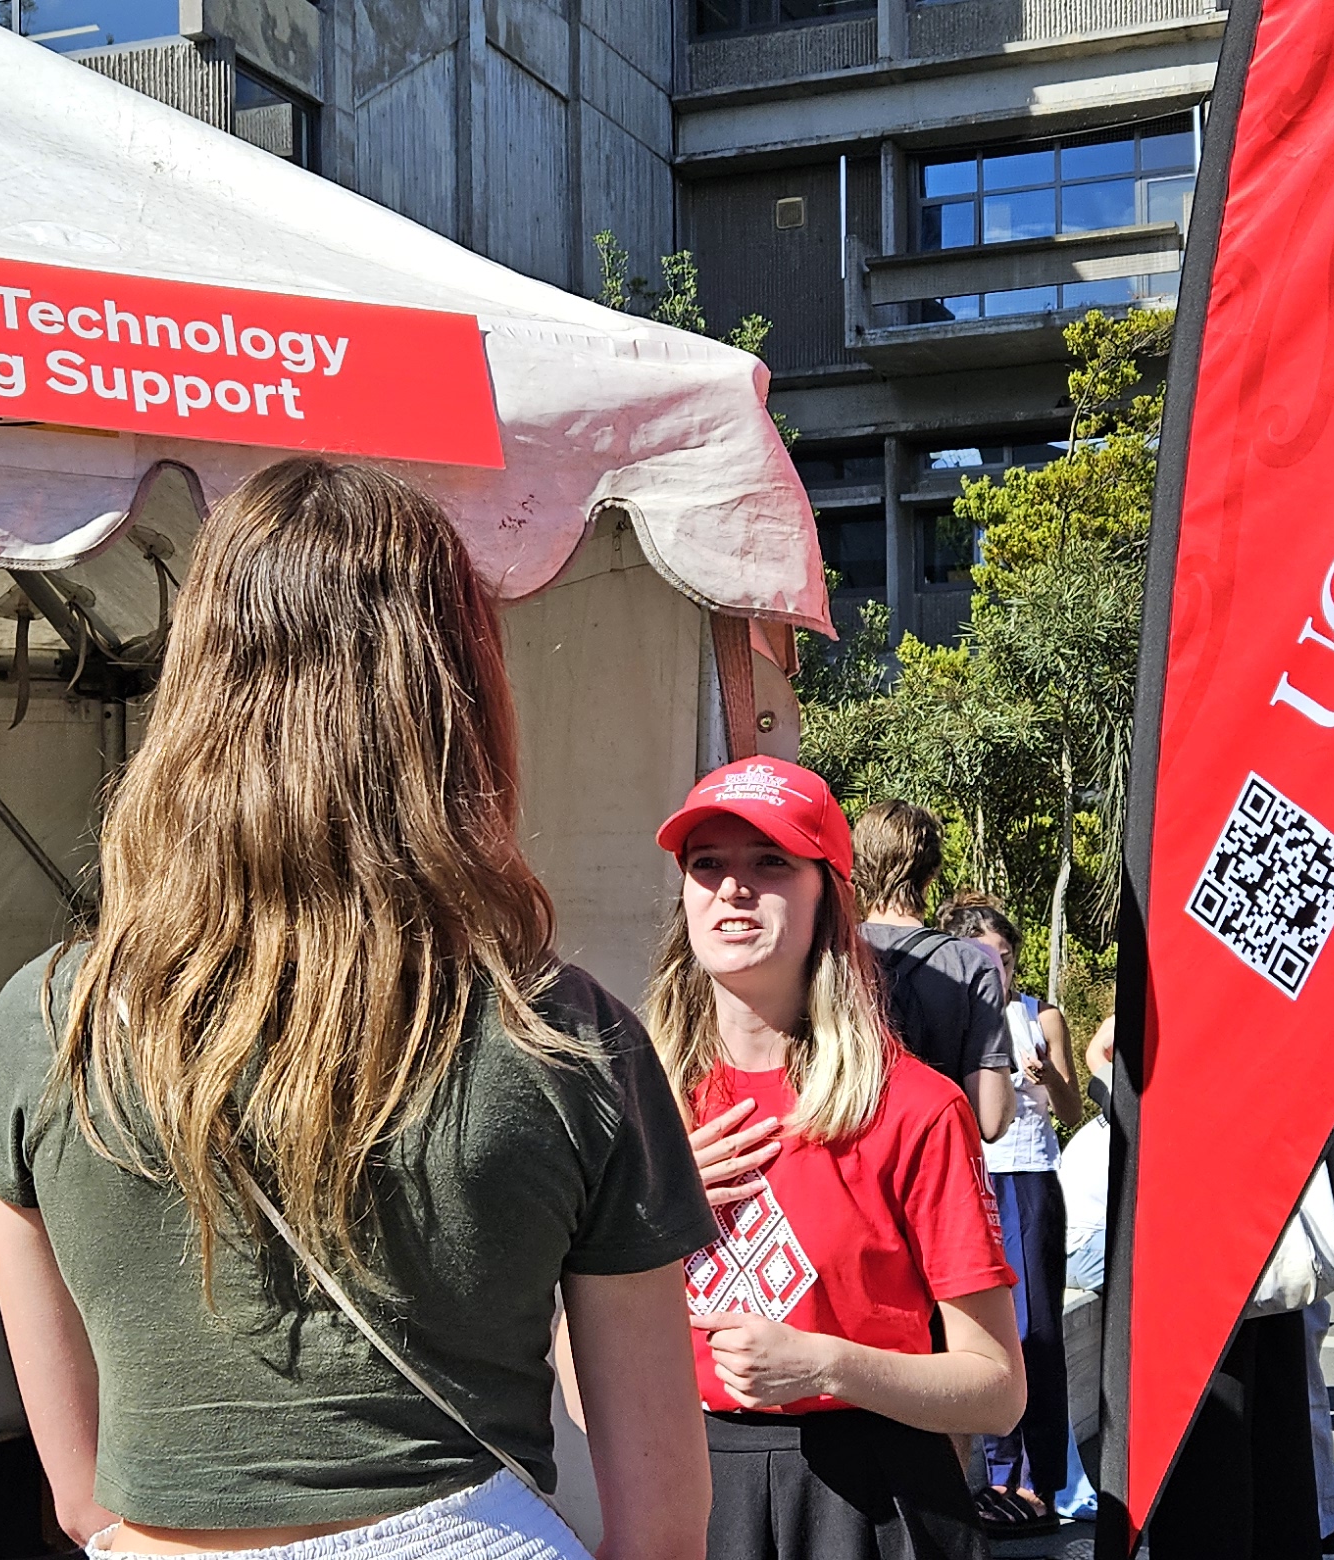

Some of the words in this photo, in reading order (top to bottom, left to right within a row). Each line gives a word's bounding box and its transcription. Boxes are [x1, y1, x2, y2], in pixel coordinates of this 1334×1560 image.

[46, 350, 305, 420] Support
[724, 784, 780, 796] Assistive
[715, 791, 787, 807] Technology
